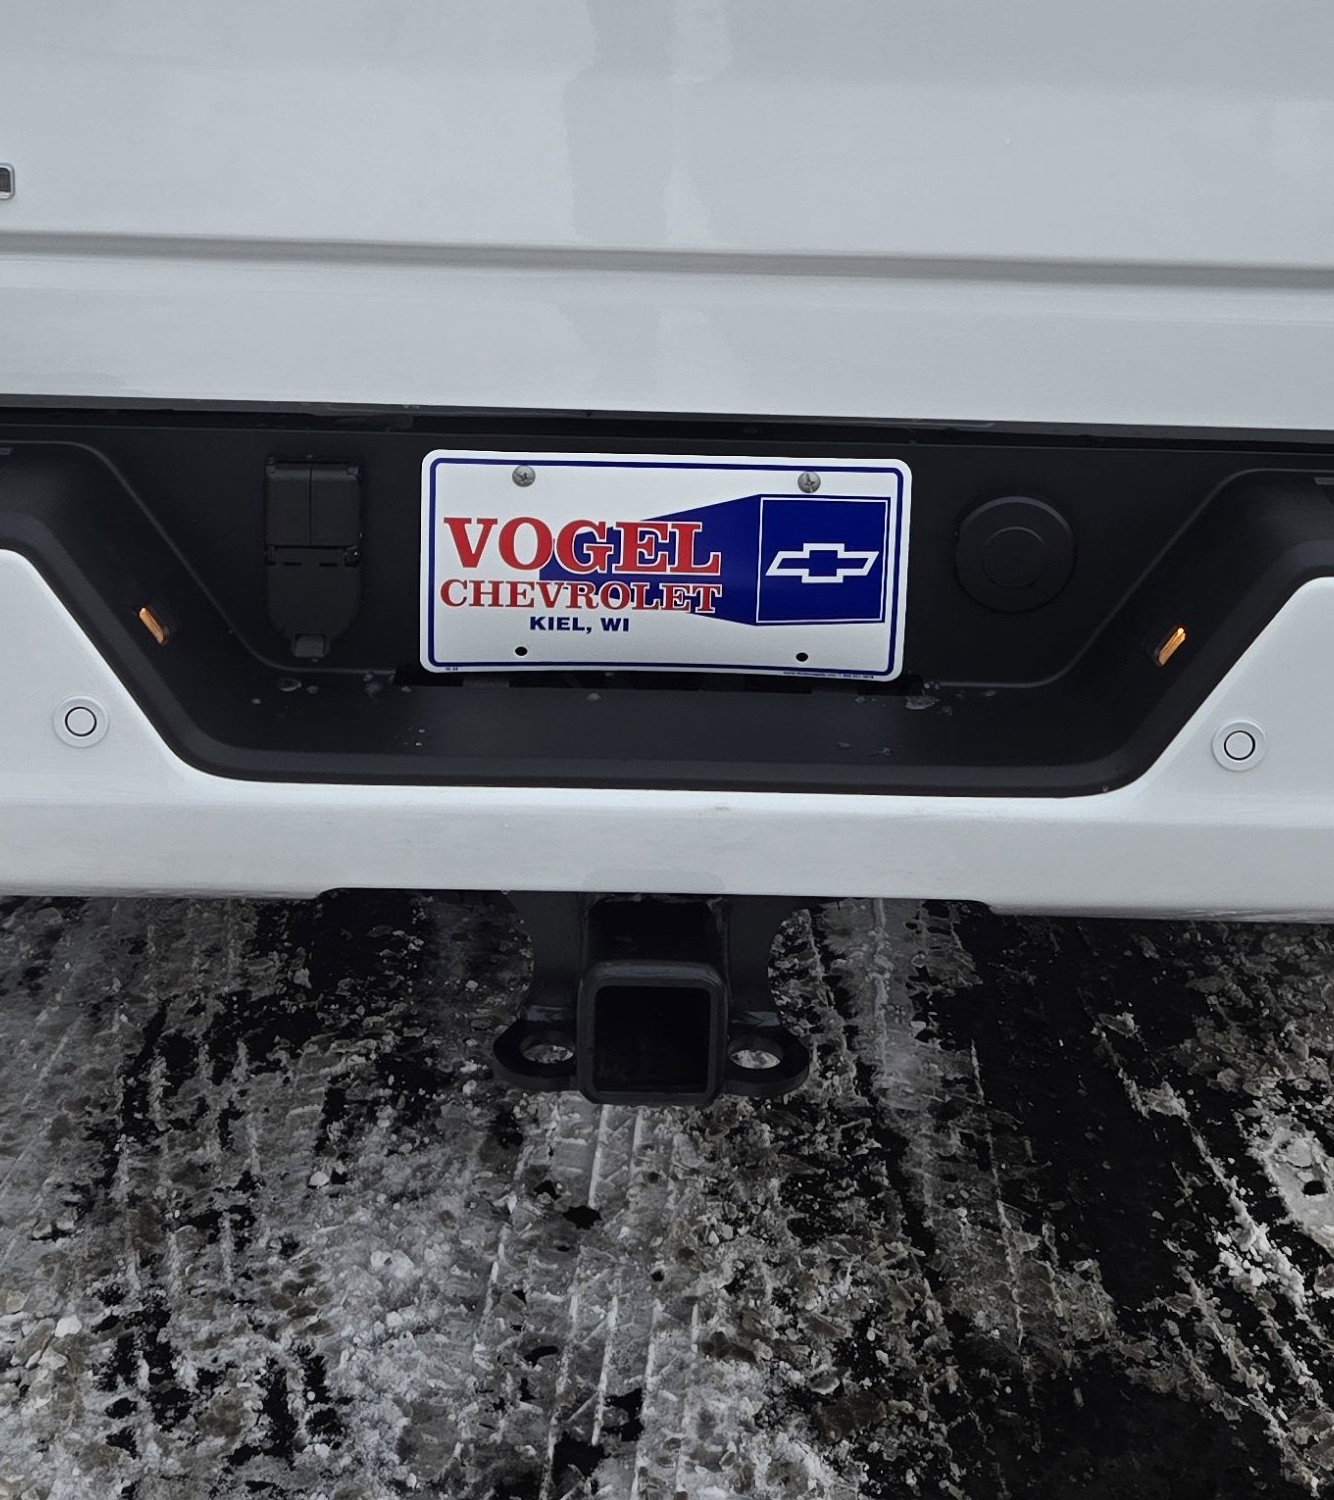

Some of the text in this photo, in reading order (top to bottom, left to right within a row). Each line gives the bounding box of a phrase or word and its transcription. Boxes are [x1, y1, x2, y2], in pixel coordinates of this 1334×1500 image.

[443, 517, 722, 575] VOGEL
[440, 578, 723, 613] CHEVROLET
[529, 616, 630, 634] KIEL, WI
